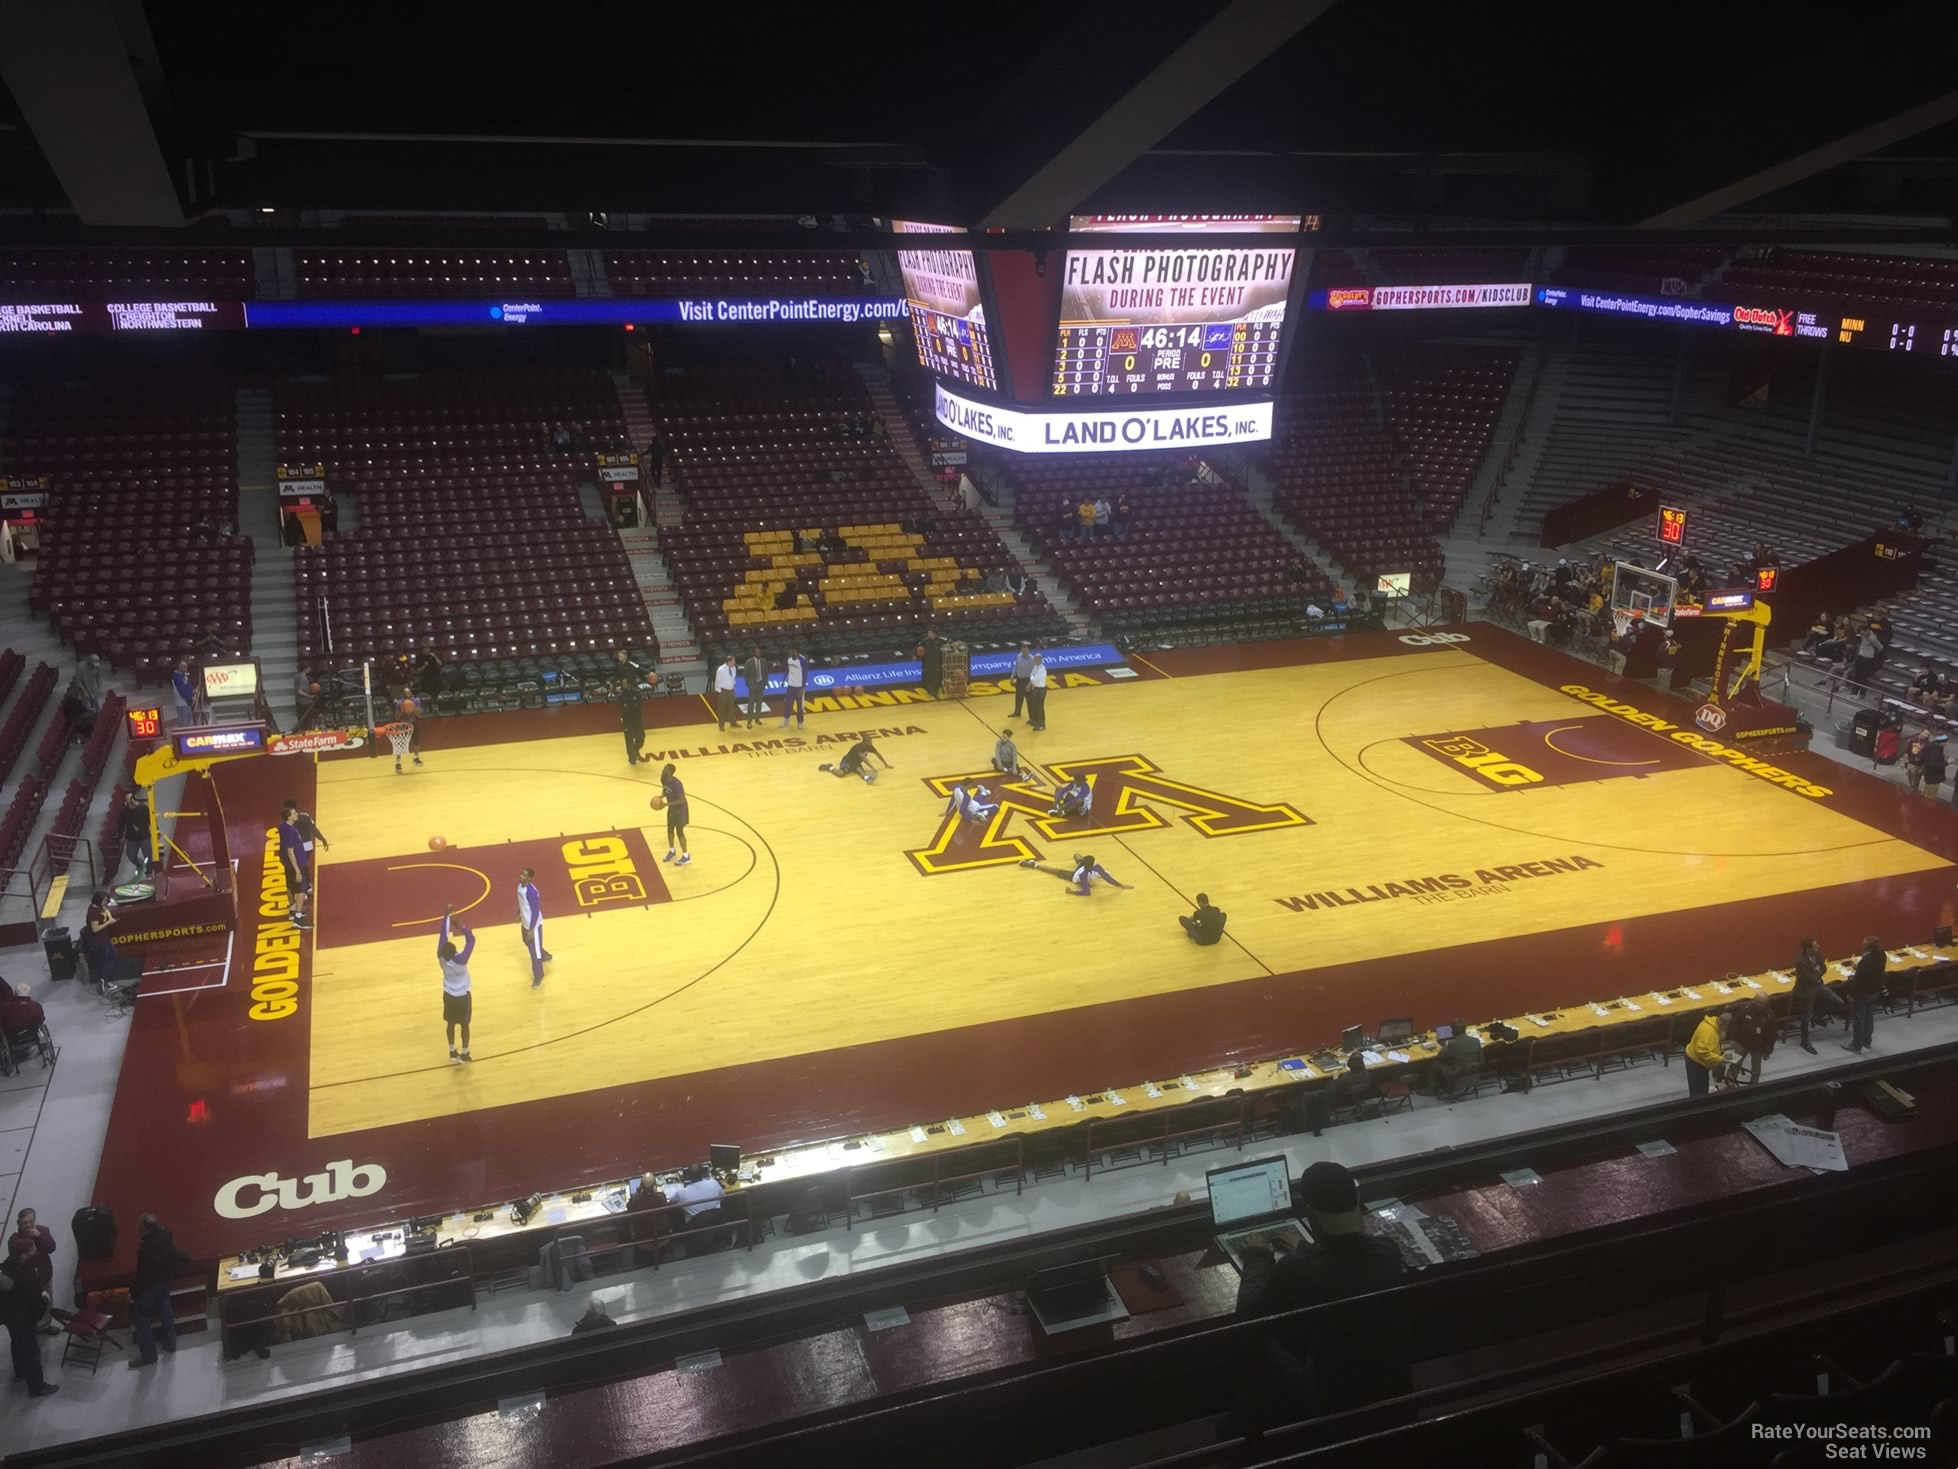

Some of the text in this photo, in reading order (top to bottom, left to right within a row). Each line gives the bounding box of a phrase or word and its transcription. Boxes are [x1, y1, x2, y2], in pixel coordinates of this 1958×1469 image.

[1068, 252, 1292, 286] FLASH PHOTOGRAPHY
[1110, 286, 1246, 308] DURING THE EVENT
[1376, 288, 1529, 305] GOPHERSPORTS.COM/KIDSCLUB
[1581, 295, 1595, 307] Visit
[16, 304, 83, 315] BASKETBALL
[107, 302, 218, 313] COLLEGE BASKETBALL
[679, 301, 713, 320] Visit
[119, 312, 176, 321] CREIGHTON
[1734, 306, 1777, 326] Old Dutch
[1799, 313, 1816, 325] FREE
[20, 321, 72, 331] CAROLINA
[119, 319, 202, 329] NORTHWESTERN
[1841, 318, 1865, 331] MINN
[1254, 331, 1261, 341] 0
[1272, 331, 1279, 341] 0
[1797, 325, 1828, 338] THROWS
[1839, 330, 1852, 343] NU
[1062, 337, 1104, 348] 1 0 0
[1141, 327, 1200, 349] 46:14
[1234, 342, 1277, 353] 10 0 0
[1060, 348, 1103, 360] 2 0 0
[1157, 350, 1181, 359] PERIOD
[1201, 352, 1211, 368] 0
[1232, 353, 1274, 365] 11 0 0
[1059, 360, 1101, 372] 3 0 0
[1125, 355, 1135, 371] 0
[1154, 358, 1181, 370] PRE
[1248, 365, 1255, 376] 0
[1265, 364, 1271, 374] 0
[1075, 372, 1082, 383] 0
[1093, 371, 1100, 382] 0
[1126, 374, 1146, 383] FOULS
[1187, 372, 1206, 381] FOULS
[1246, 376, 1253, 386] 0
[1263, 375, 1270, 386] 0
[1053, 383, 1099, 395] 22 0 0
[1108, 384, 1115, 394] 4
[1131, 383, 1138, 393] 0
[1192, 380, 1199, 390] 0
[1213, 379, 1220, 389] 4
[997, 424, 1016, 442] INC.
[1045, 414, 1259, 445] LAND O'LAKES, INC.
[1664, 521, 1680, 540] 30
[1760, 579, 1772, 589] 30
[1398, 632, 1471, 646] Cub
[845, 673, 882, 684] Allianz
[884, 669, 904, 681] Life
[1059, 652, 1102, 666] America
[1701, 709, 1722, 729] DQ
[137, 721, 155, 735] 30
[638, 725, 928, 763] WILLIAMS ARENA
[1560, 685, 1834, 798] GOLDEN GOPHERS
[1273, 855, 1606, 914] WILLIAMS ARENA
[1409, 884, 1512, 906] THE BARN
[111, 922, 227, 945] GOPHERSPORTS.com
[248, 920, 302, 1021] GOLDEN
[213, 1159, 387, 1220] Cub
